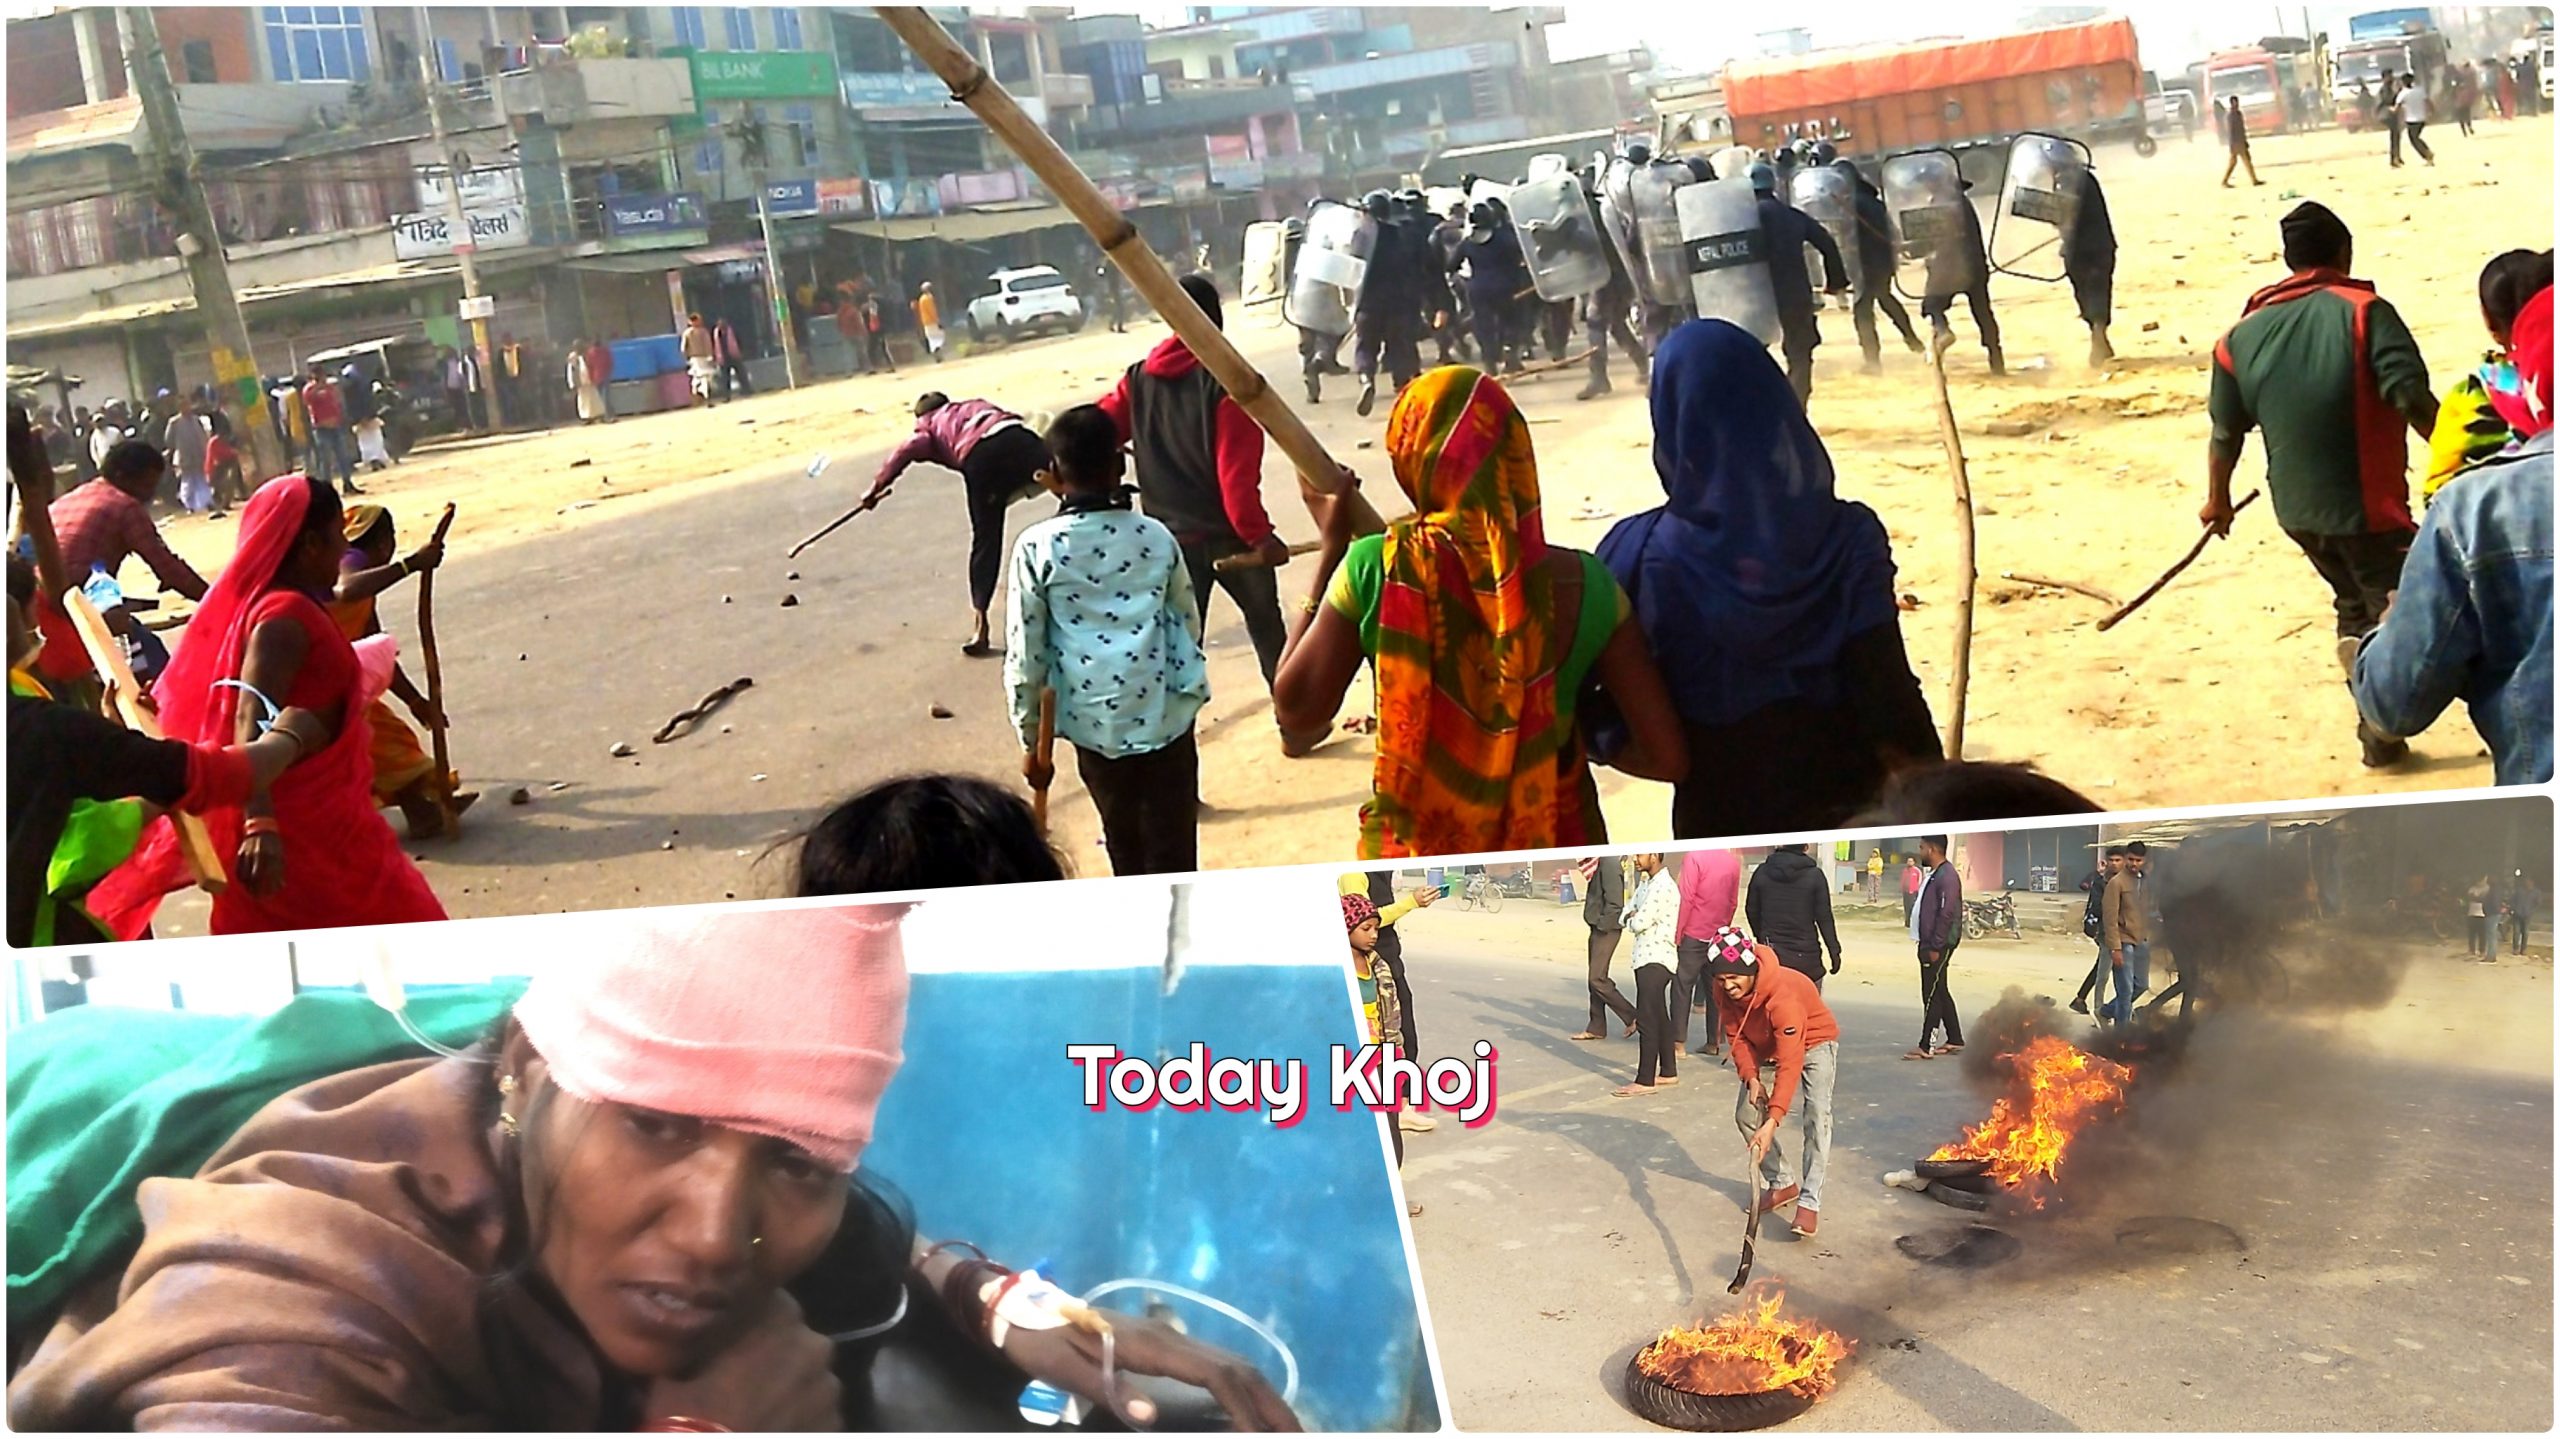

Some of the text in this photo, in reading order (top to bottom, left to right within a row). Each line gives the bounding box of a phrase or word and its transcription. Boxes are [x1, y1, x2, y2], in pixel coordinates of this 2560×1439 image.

[723, 59, 765, 79] BANK
[767, 185, 803, 199] NOKIA
[613, 208, 665, 225] Yasuda
[1697, 240, 1750, 262] NEPAL POLICE
